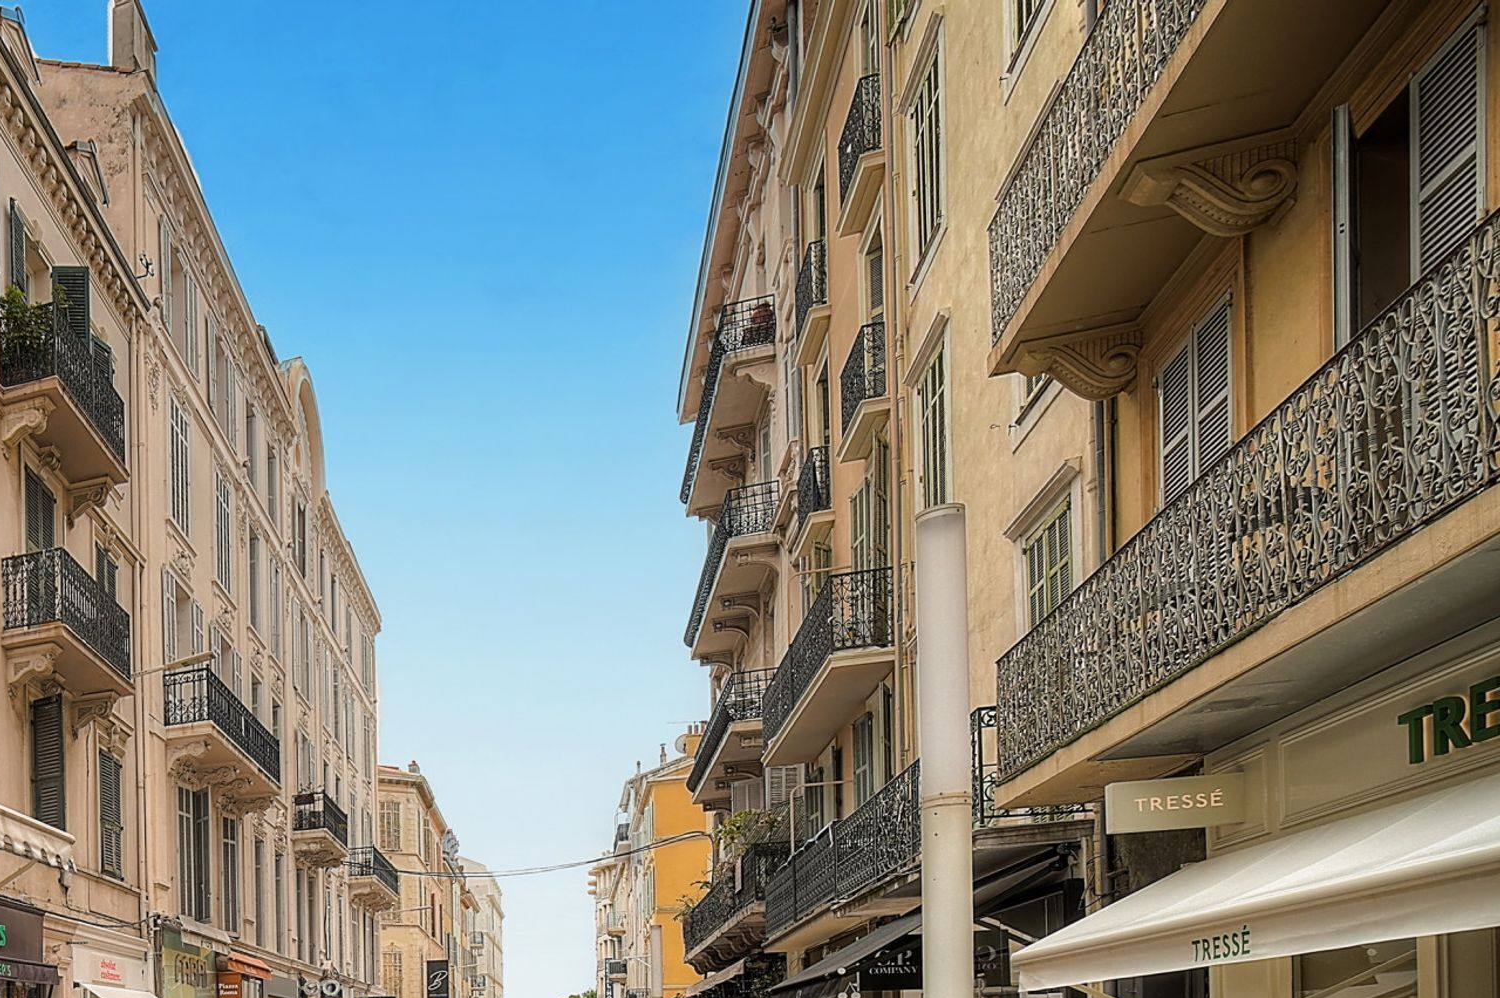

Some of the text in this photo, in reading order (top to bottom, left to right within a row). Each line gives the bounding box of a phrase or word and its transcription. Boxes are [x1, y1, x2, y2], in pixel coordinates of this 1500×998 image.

[1397, 676, 1500, 765] TRE
[1134, 789, 1224, 812] TRESSÉ
[1191, 925, 1251, 962] TRESSÉ
[869, 965, 919, 976] COMPANY
